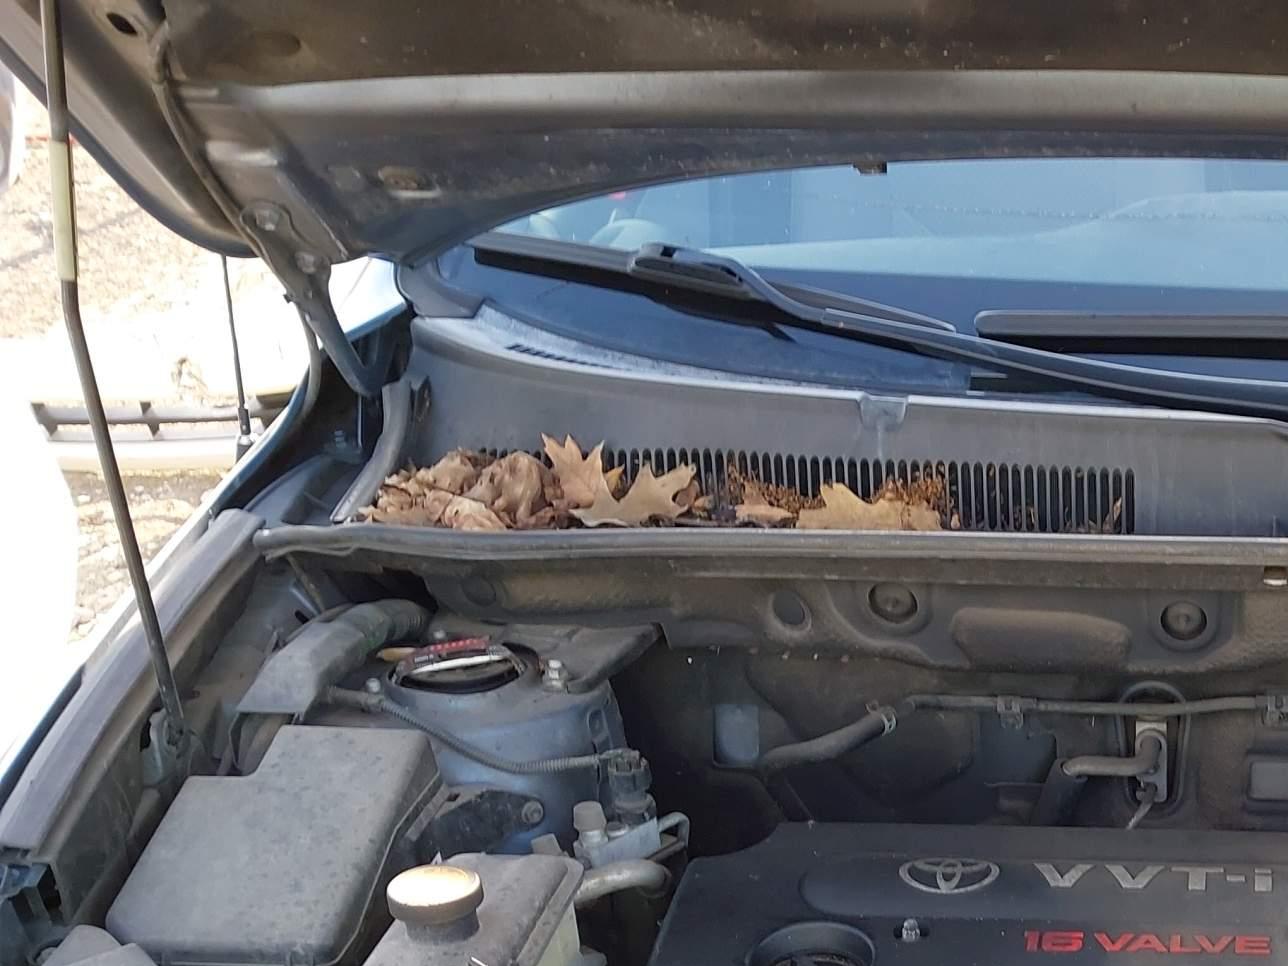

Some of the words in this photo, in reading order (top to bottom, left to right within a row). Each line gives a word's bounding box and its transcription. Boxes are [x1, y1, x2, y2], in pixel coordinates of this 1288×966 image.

[1033, 862, 1273, 893] VVT-i
[1024, 930, 1086, 953] 16
[1093, 932, 1273, 955] VALVE
